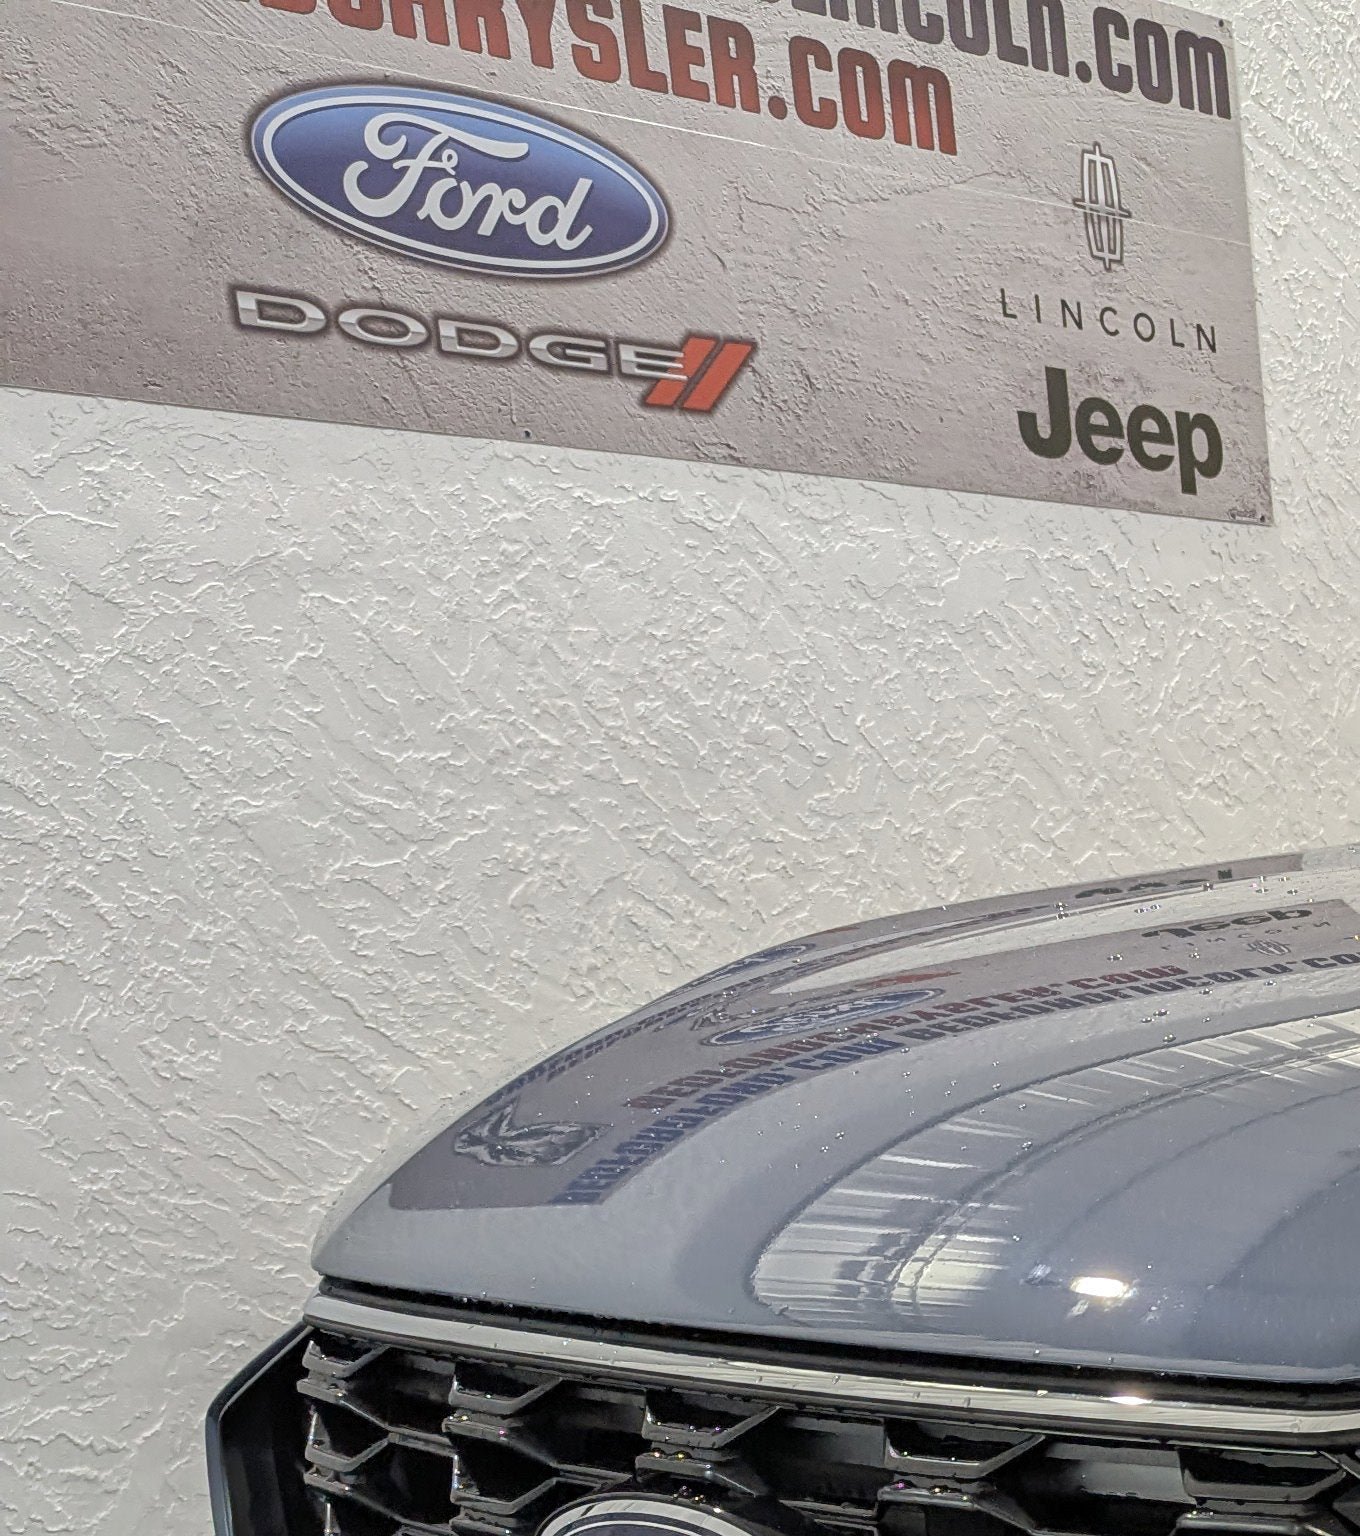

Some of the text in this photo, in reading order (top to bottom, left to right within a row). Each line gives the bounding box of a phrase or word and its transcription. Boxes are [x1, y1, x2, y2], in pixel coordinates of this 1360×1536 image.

[342, 112, 594, 251] Ford
[236, 290, 689, 383] DODGE
[1000, 288, 1217, 353] LINCOLN
[1017, 366, 1223, 495] Jeep
